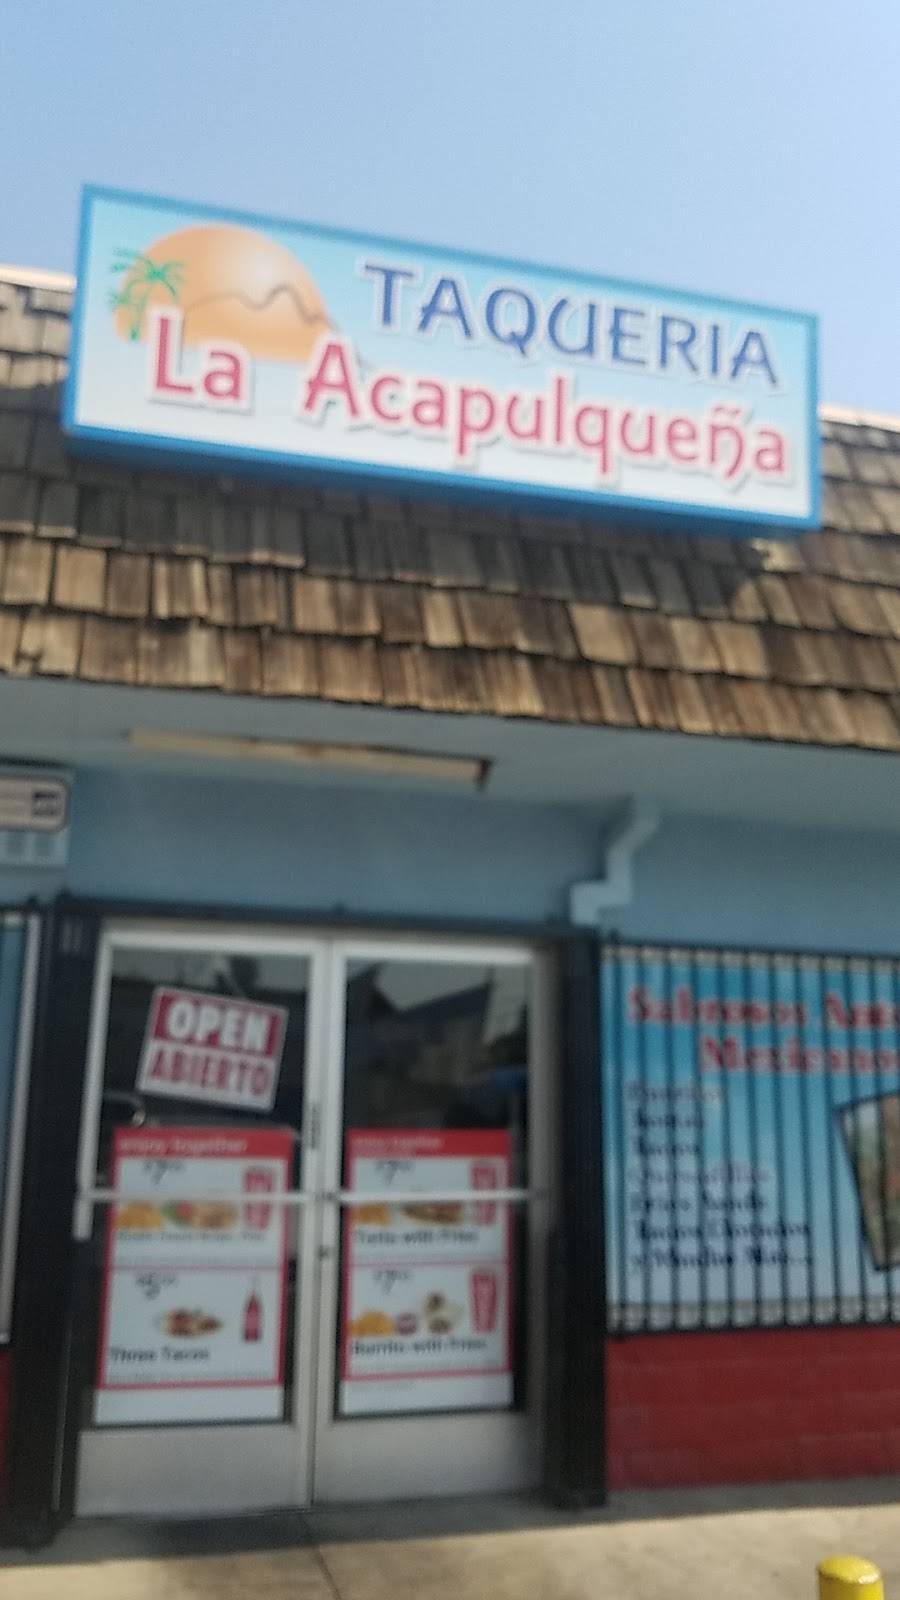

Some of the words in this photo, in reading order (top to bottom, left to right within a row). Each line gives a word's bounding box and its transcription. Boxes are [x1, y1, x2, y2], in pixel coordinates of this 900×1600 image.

[363, 261, 780, 387] TAQUERIA
[153, 316, 248, 402] La
[302, 342, 790, 479] Acapulqueña
[166, 999, 271, 1050] OPEN
[148, 1047, 271, 1098] ABIERTO
